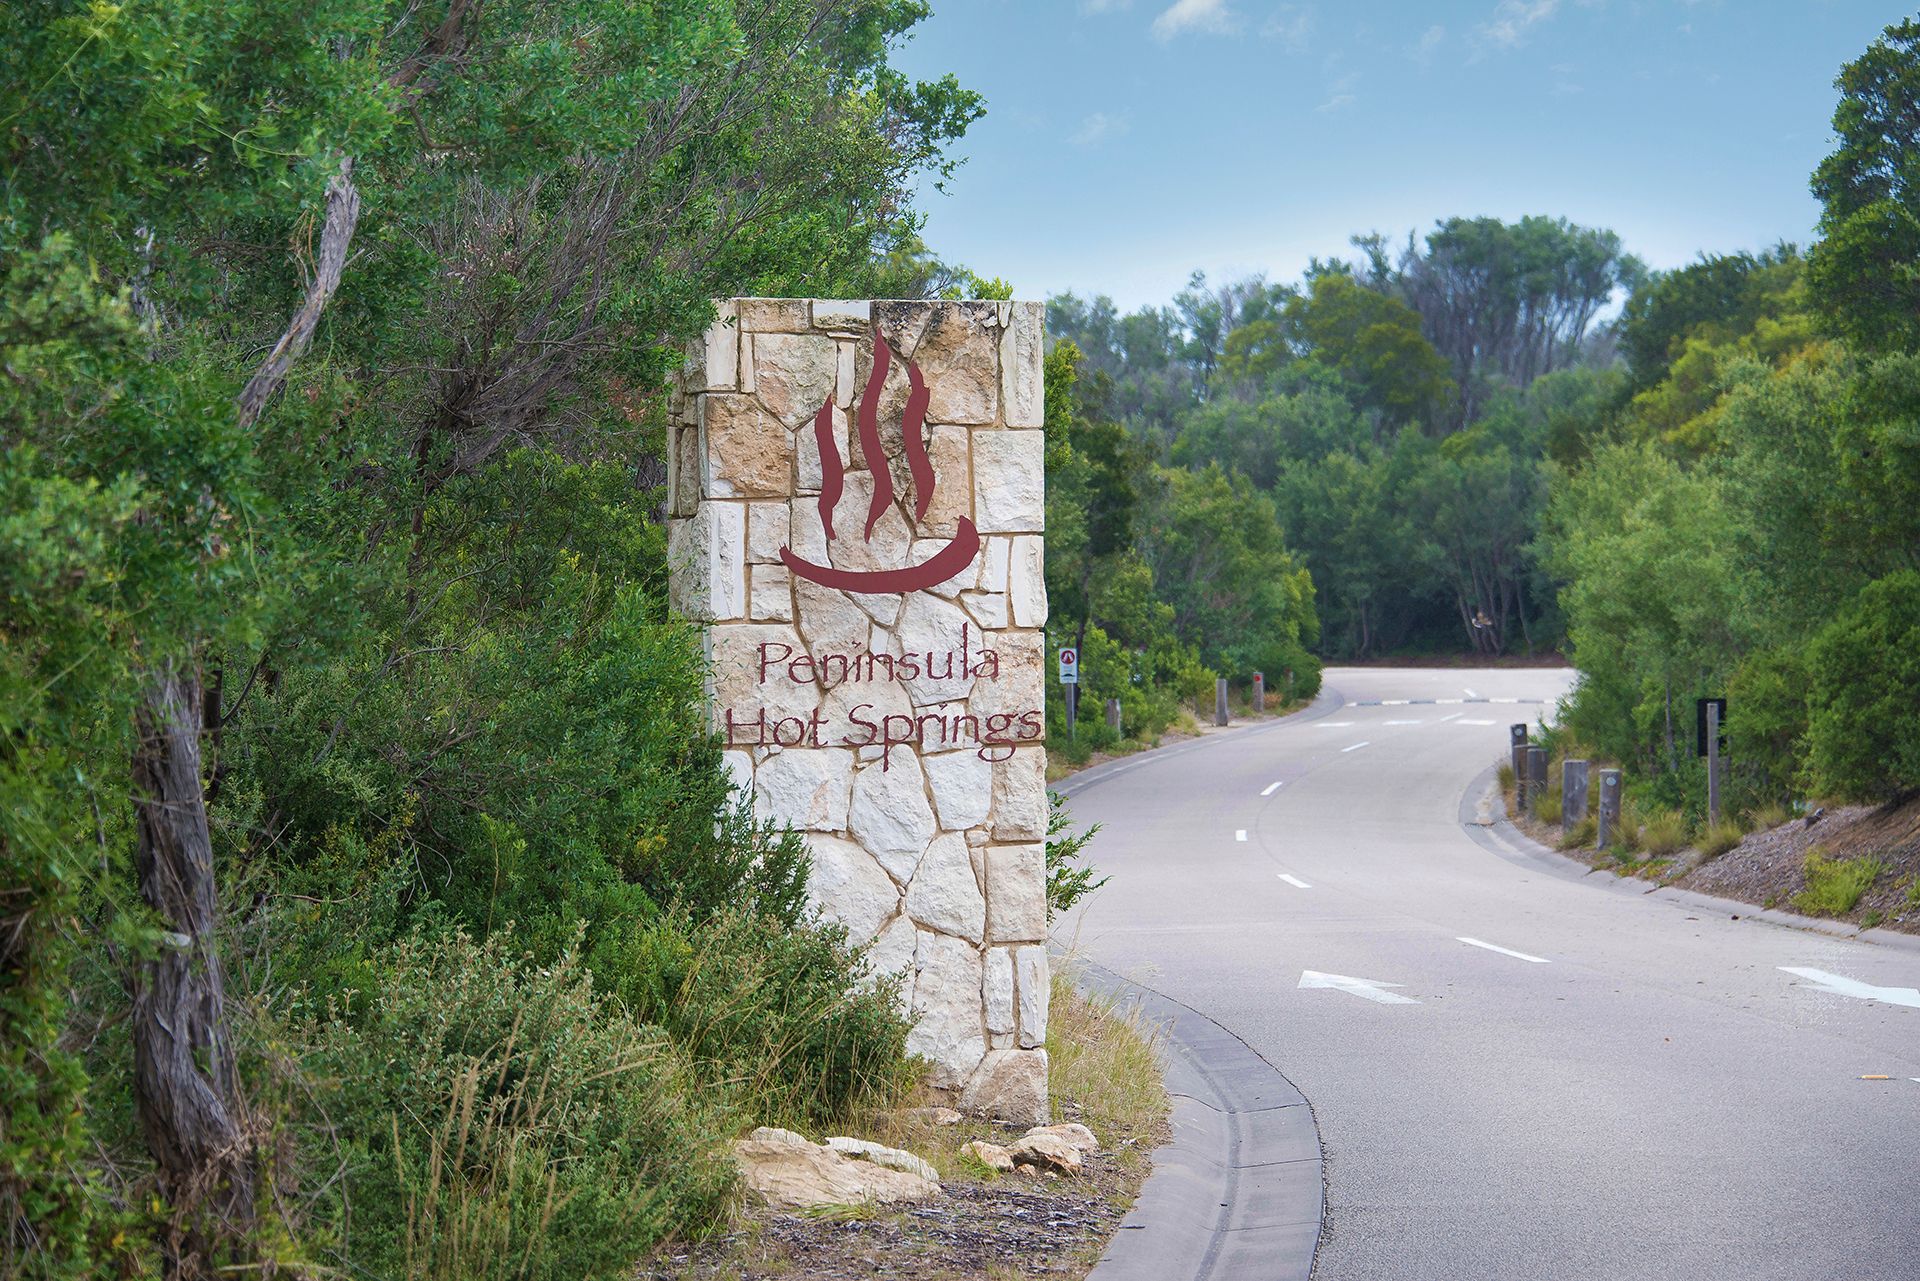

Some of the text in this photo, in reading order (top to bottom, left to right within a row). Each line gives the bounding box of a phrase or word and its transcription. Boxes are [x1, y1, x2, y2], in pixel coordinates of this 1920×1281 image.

[757, 621, 1000, 685] Peninsula
[725, 703, 1042, 773] Hot Springs
